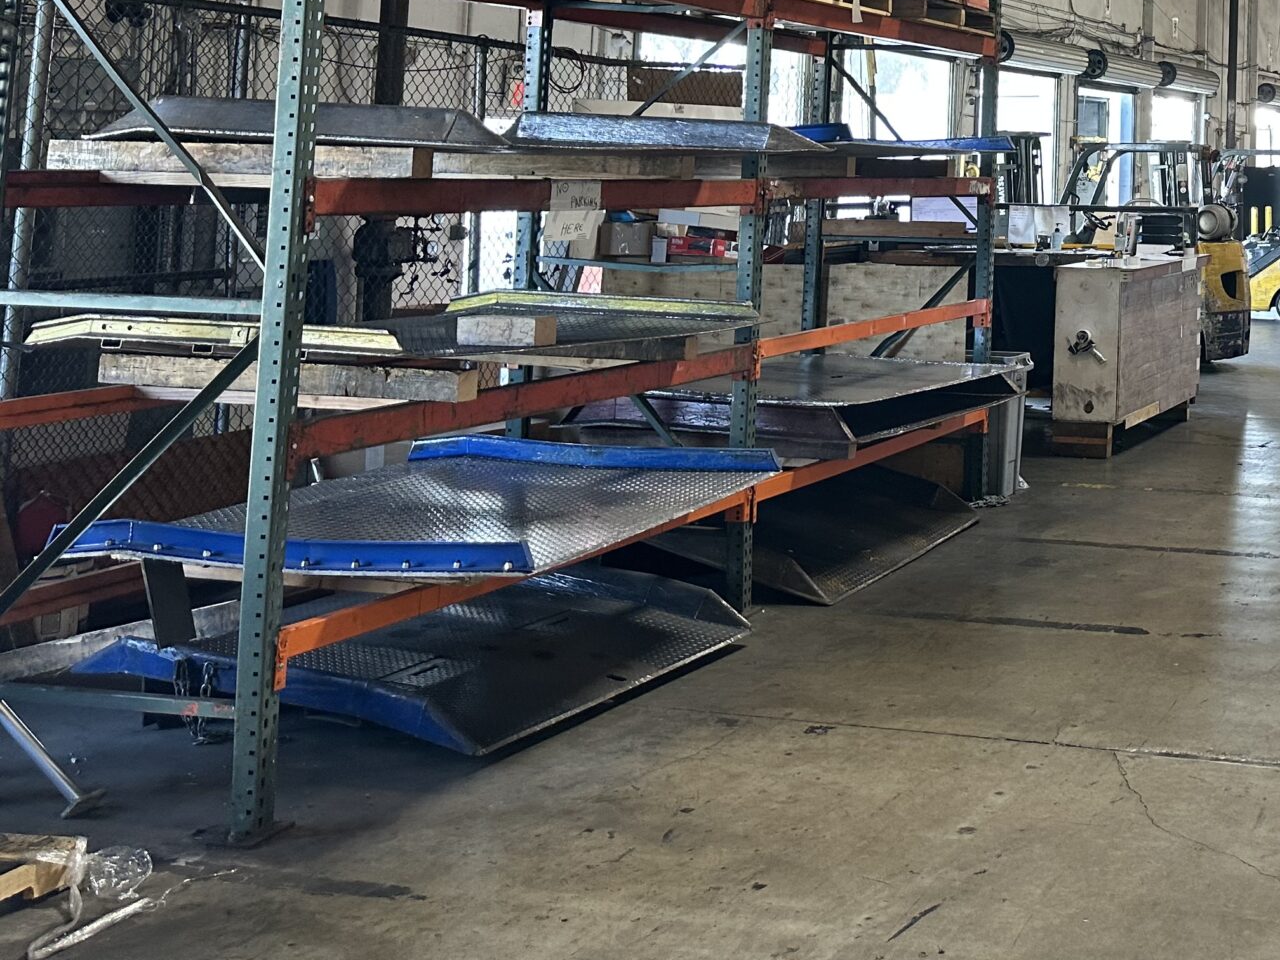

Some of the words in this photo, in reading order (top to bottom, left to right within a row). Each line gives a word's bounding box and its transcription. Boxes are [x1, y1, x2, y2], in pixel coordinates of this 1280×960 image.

[556, 182, 570, 197] NO
[996, 175, 1006, 216] KMATSU
[560, 222, 584, 237] HERE
